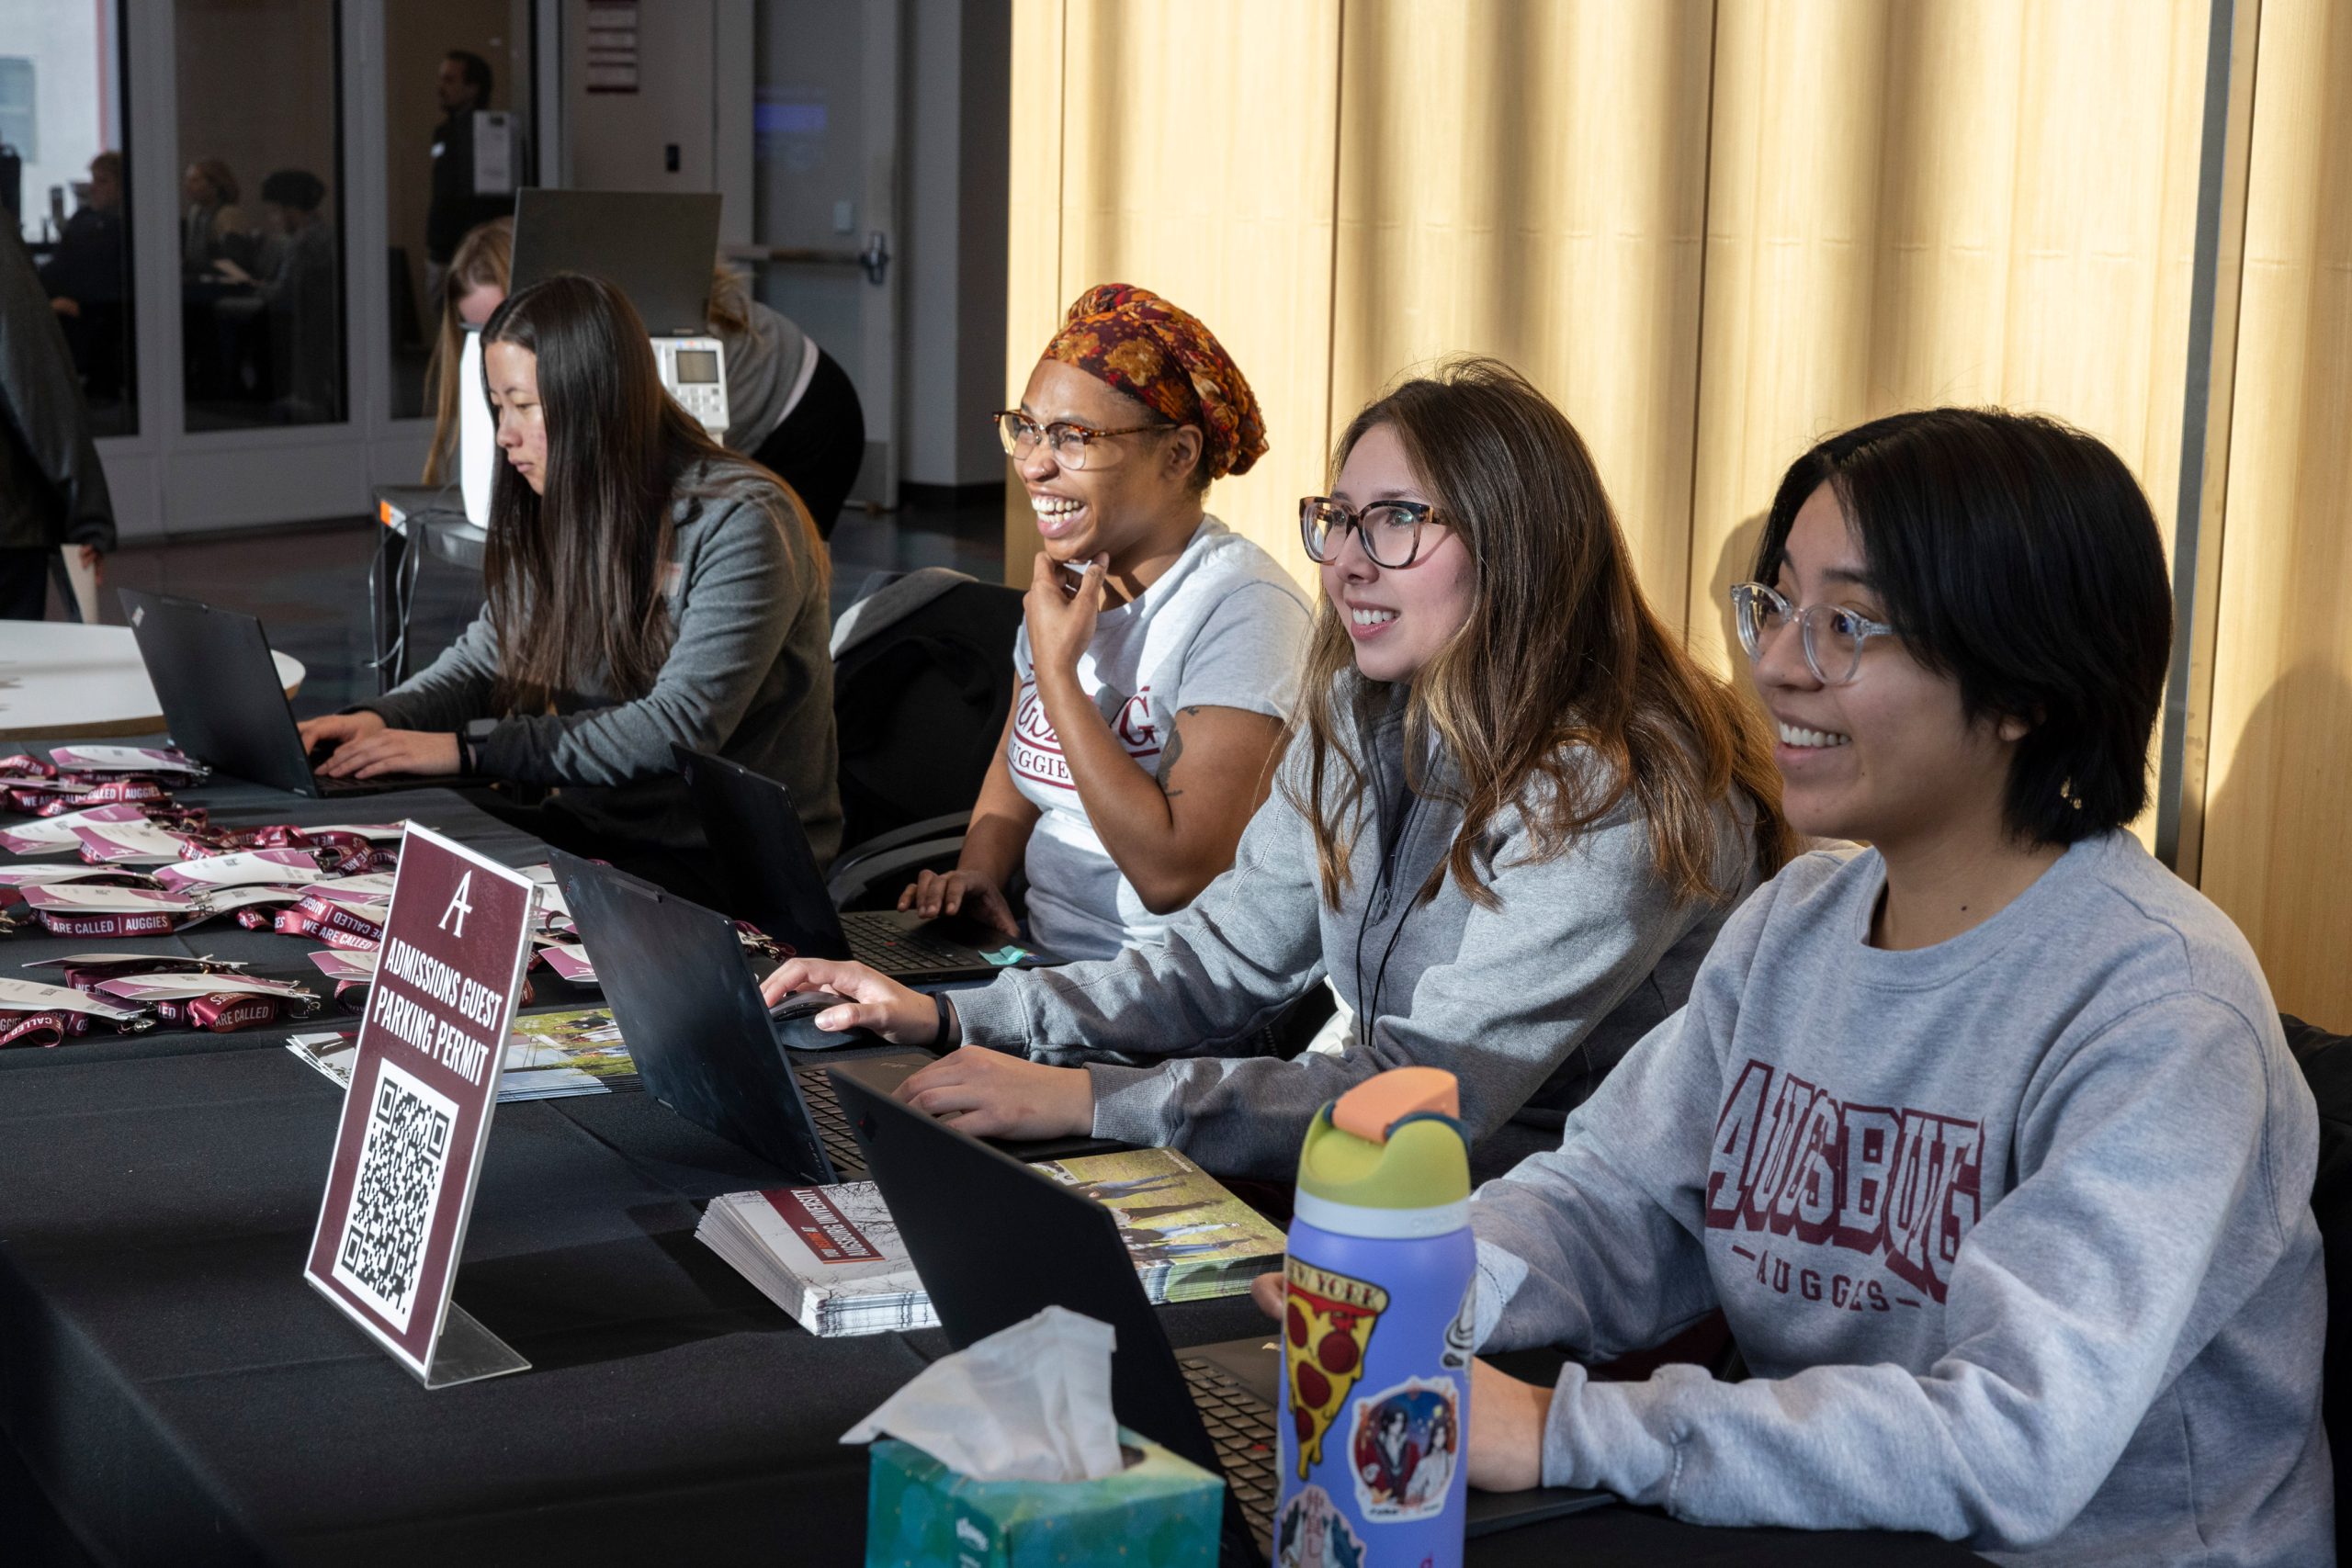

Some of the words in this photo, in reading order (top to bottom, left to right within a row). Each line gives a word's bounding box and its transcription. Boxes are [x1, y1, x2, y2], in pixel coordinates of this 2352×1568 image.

[1010, 740, 1069, 779] UGGIE
[22, 795, 38, 807] WE
[124, 786, 161, 799] AUGGIES
[300, 897, 326, 915] AUGG
[438, 869, 473, 938] A
[52, 921, 73, 933] ARE
[74, 920, 115, 934] CALLED
[125, 916, 168, 931] AUGGIES
[302, 919, 320, 934] WE
[320, 924, 338, 942] ARE
[339, 933, 373, 951] CALLED
[334, 911, 371, 935] CALLED
[384, 937, 461, 1009] ADMISSIONS
[459, 976, 503, 1032] GUEST
[11, 1017, 52, 1036] CALLED
[214, 1012, 232, 1028] ARE
[234, 1006, 269, 1021] CALLED
[373, 985, 435, 1055] PARKING
[433, 1022, 490, 1087] PERMIT
[790, 1190, 840, 1224] UNIVERSITY
[822, 1224, 871, 1257] AUGSBURG
